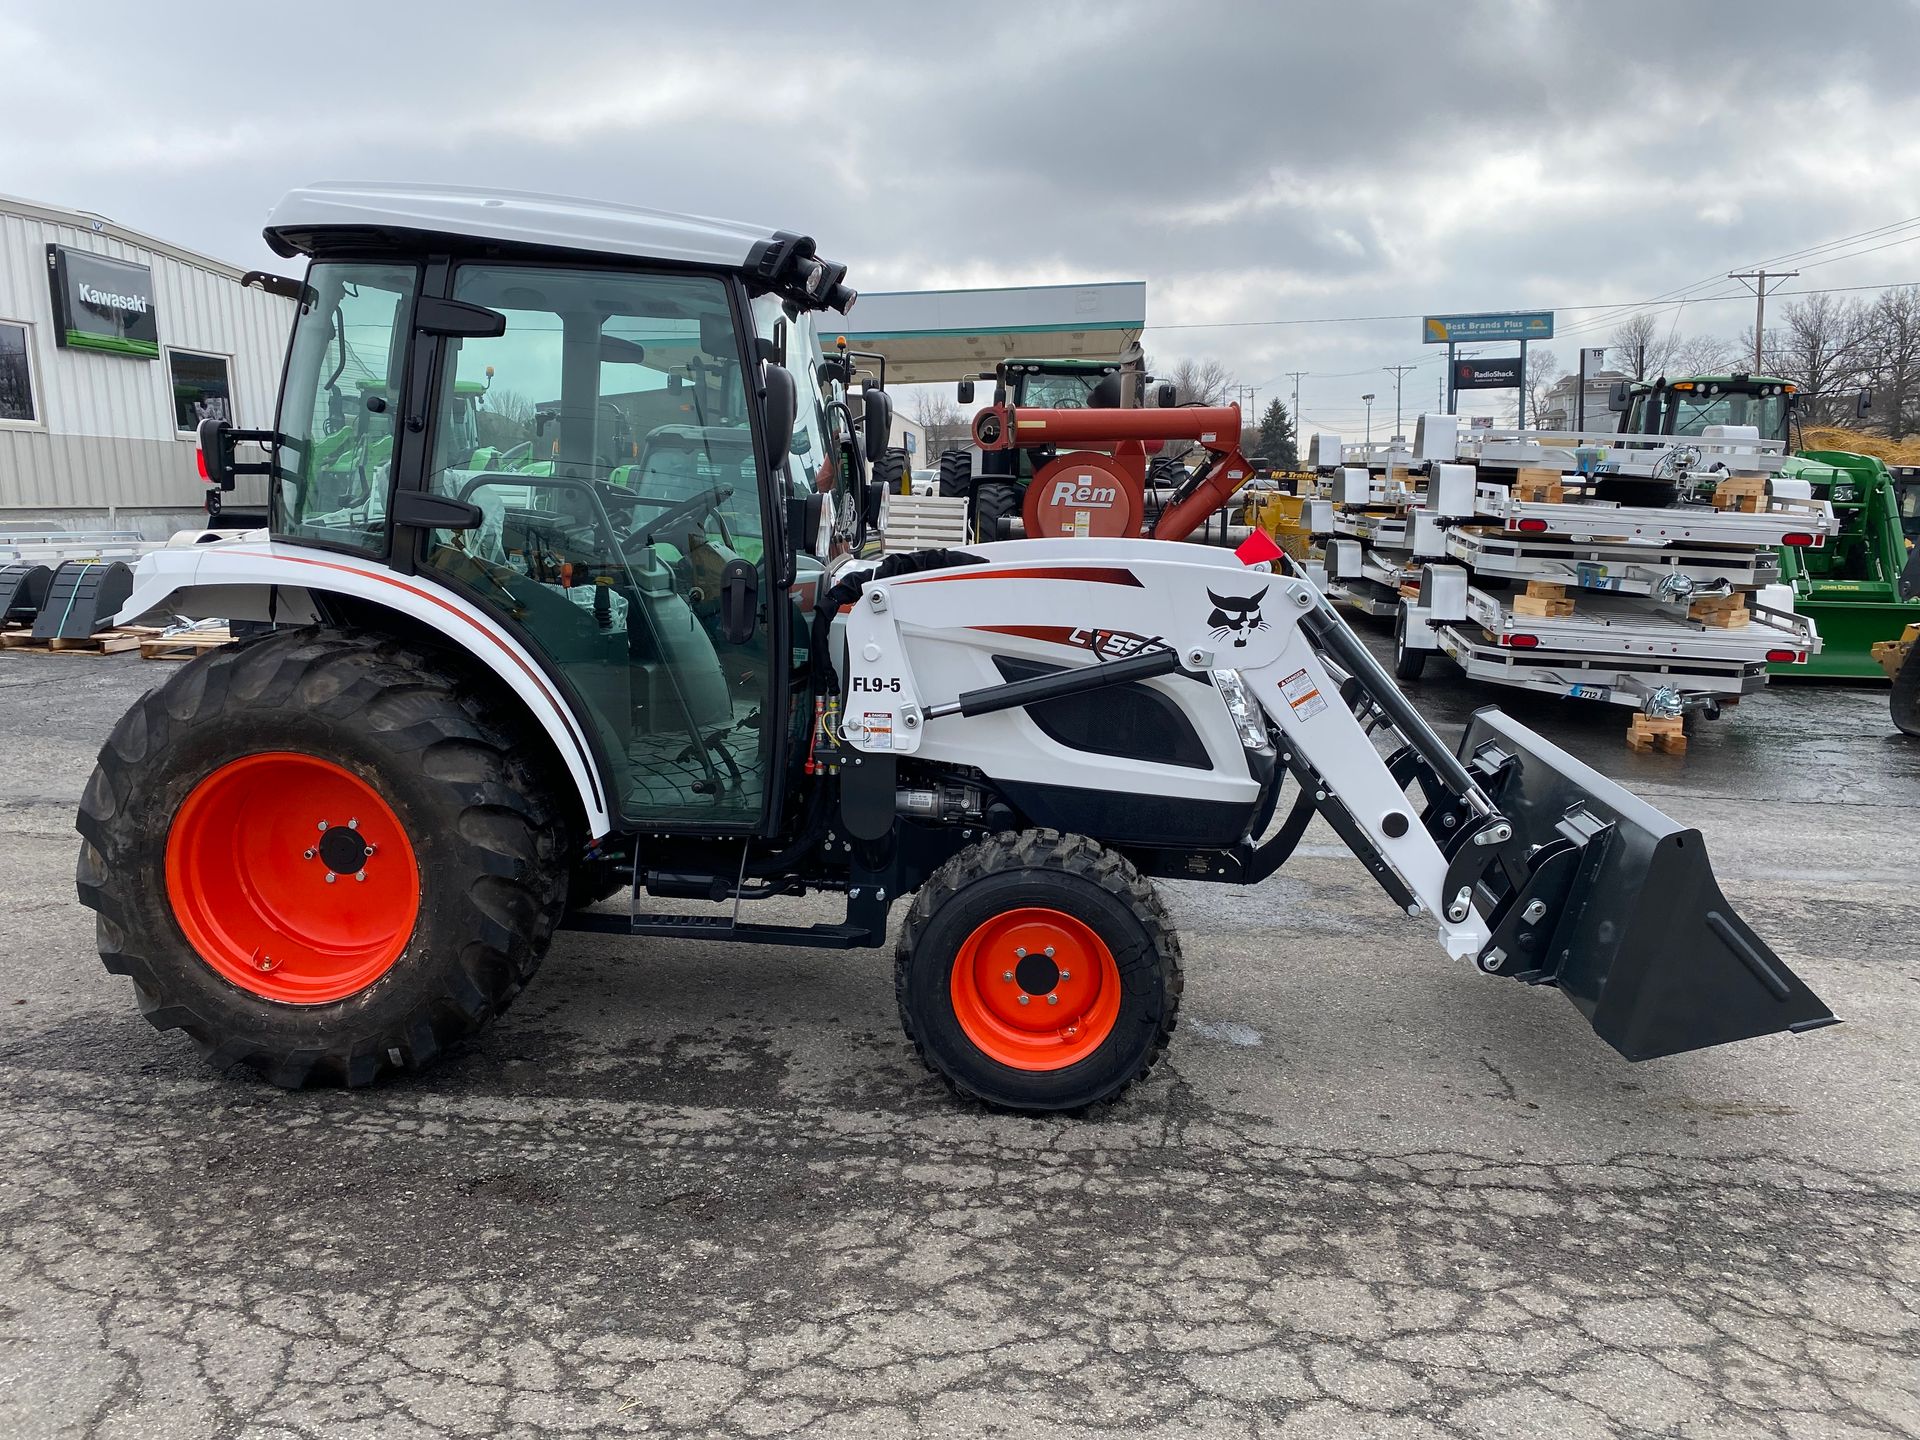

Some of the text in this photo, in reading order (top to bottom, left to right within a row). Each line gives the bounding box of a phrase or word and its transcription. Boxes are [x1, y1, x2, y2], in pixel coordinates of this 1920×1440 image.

[79, 282, 147, 313] Kawasaki
[1469, 321, 1501, 329] Brands
[1504, 320, 1523, 328] Plus
[1474, 370, 1515, 378] RadioShack
[1271, 471, 1286, 479] HP
[1050, 482, 1116, 508] Rem
[853, 677, 901, 692] FL9-5
[1579, 690, 1598, 699] 7712
